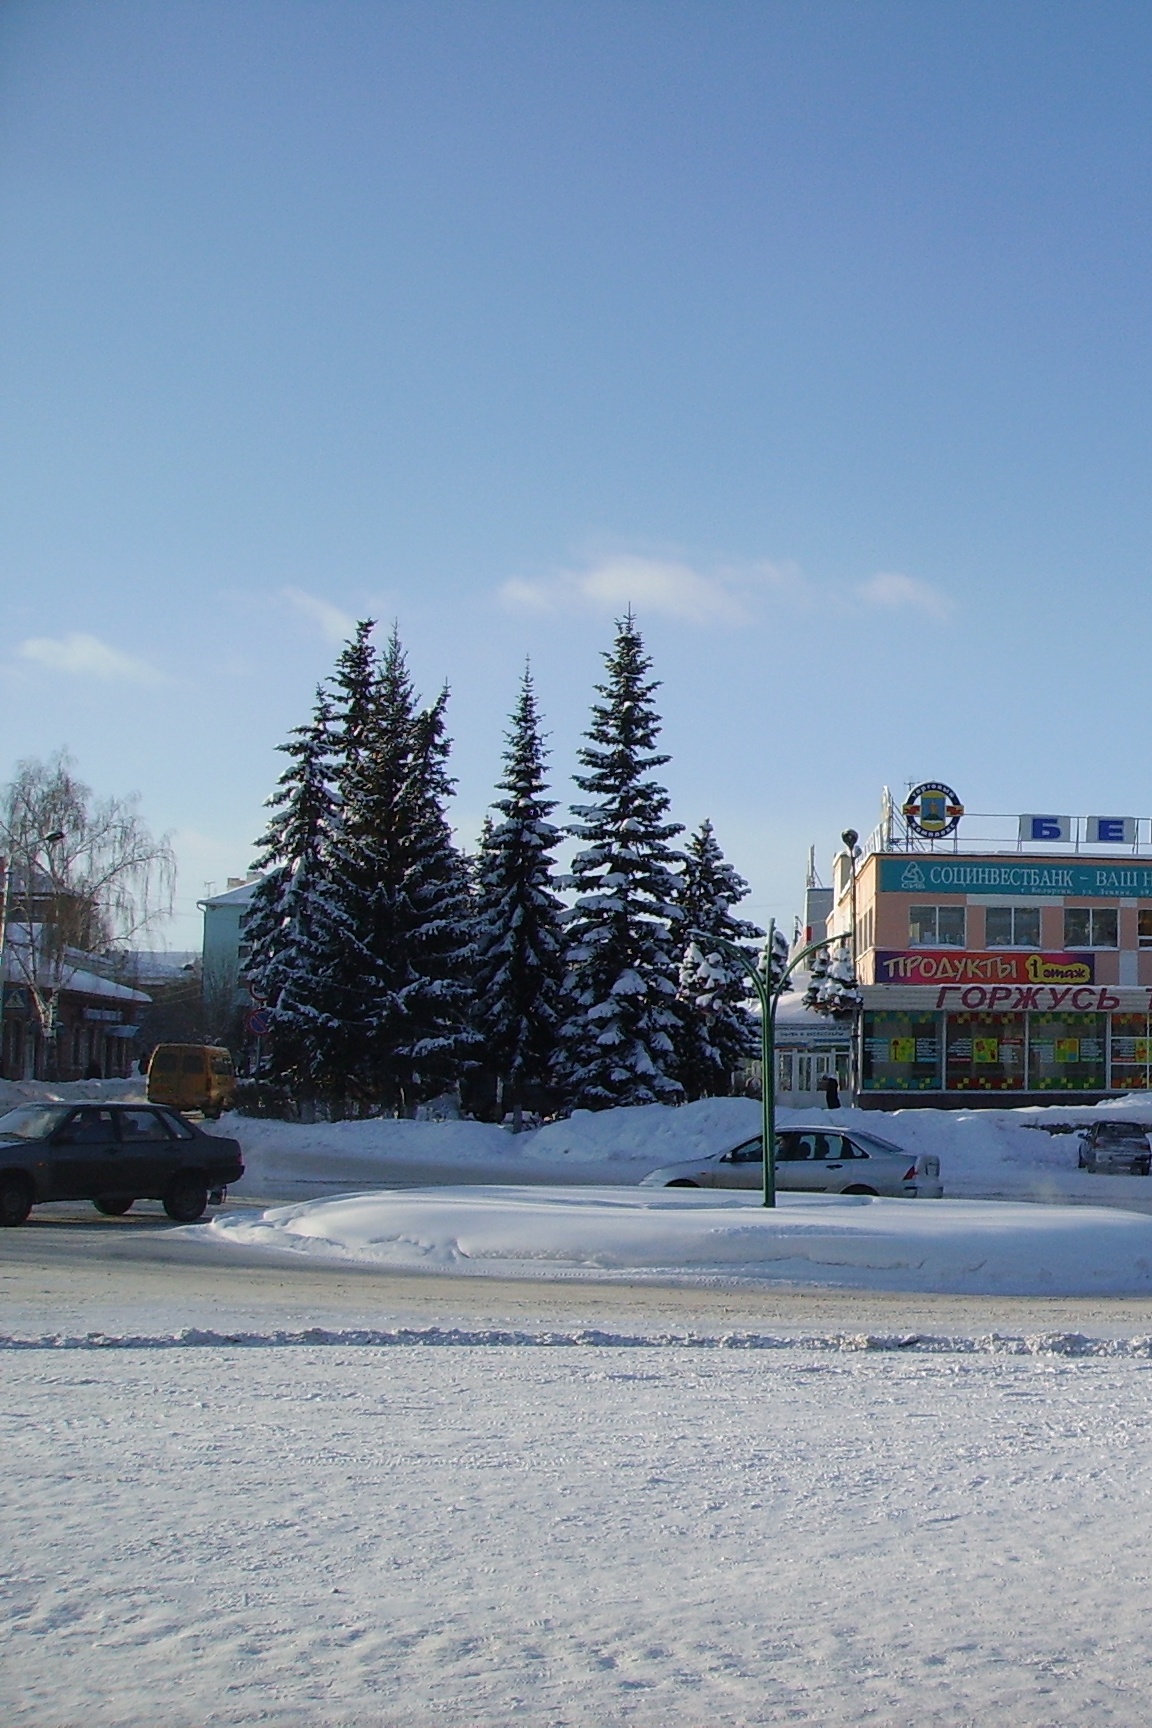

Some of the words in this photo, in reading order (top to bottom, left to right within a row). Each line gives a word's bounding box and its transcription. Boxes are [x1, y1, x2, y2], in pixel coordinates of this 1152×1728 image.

[930, 866, 1074, 887] СОЦИНВЕСТБАНК
[1096, 870, 1137, 887] ВАШ
[883, 955, 1017, 981] ПРОДУКТЫ
[1030, 956, 1039, 978] 1
[1043, 966, 1086, 979] этаж
[936, 986, 1120, 1010] ГОРЖУСЬ
